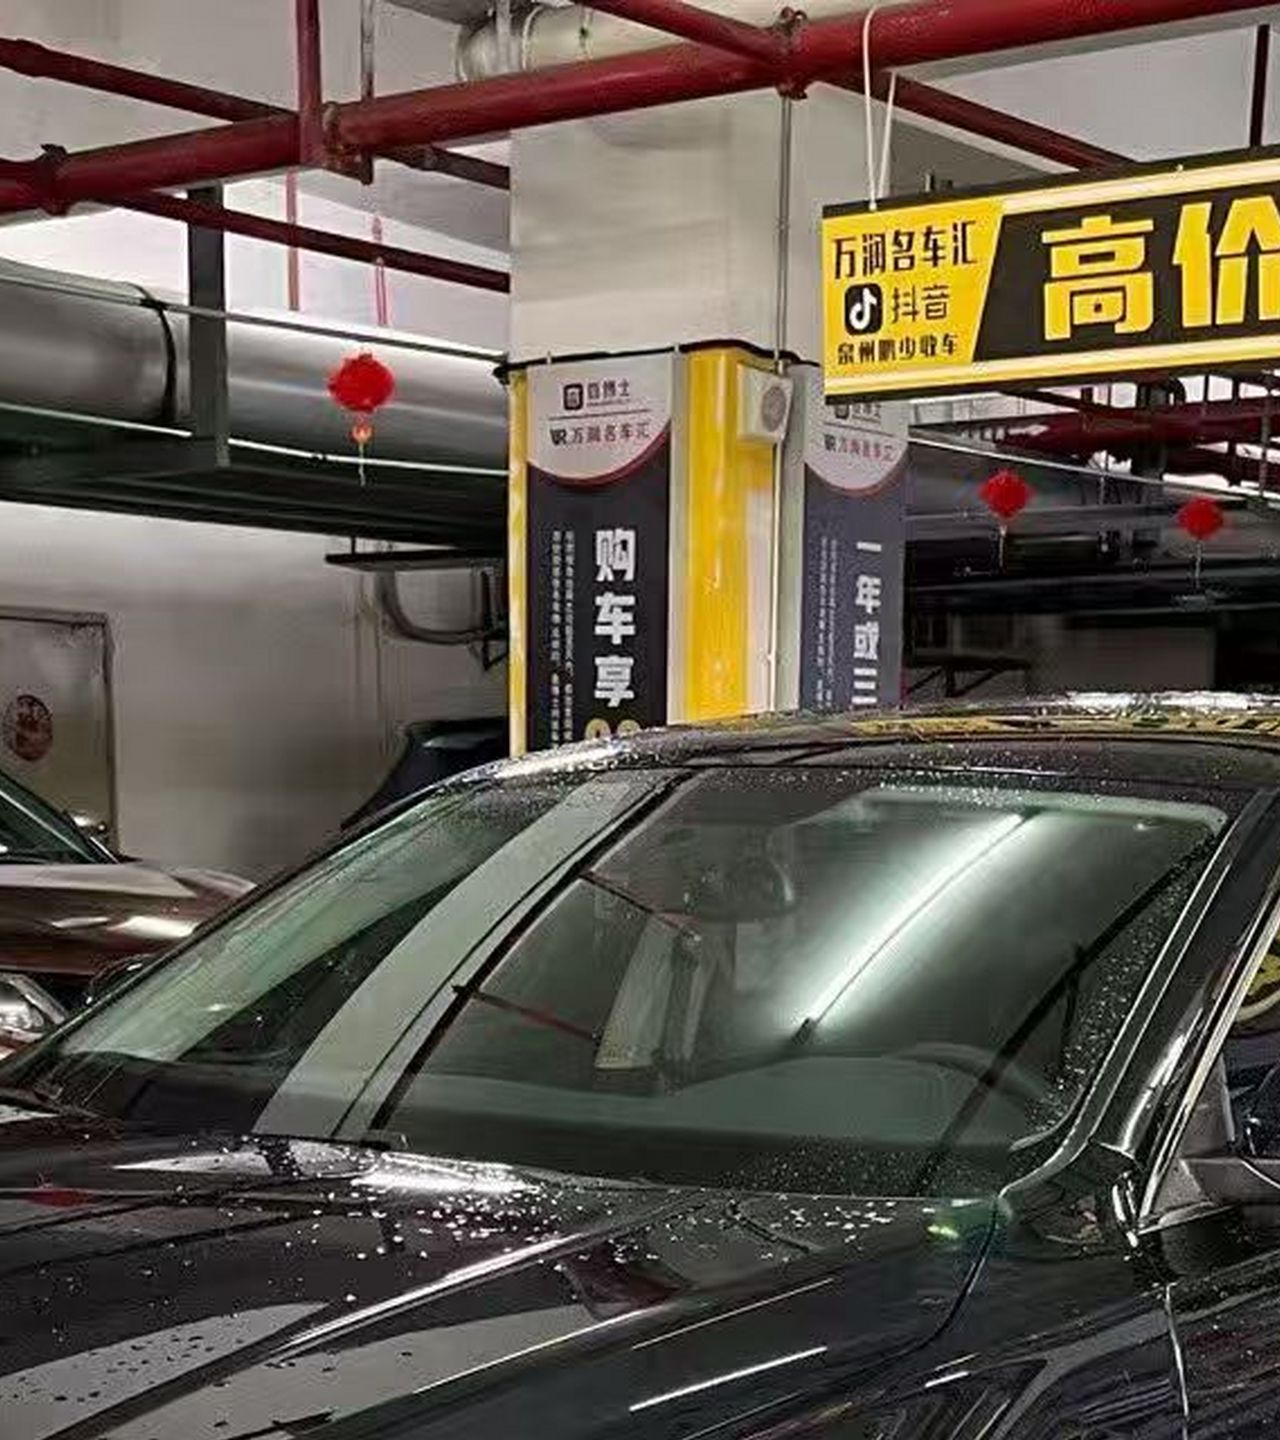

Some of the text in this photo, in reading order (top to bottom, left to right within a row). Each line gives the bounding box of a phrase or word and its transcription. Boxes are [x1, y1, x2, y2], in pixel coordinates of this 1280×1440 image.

[831, 221, 977, 280] 万润名车汇
[891, 284, 950, 325] 抖音
[594, 528, 636, 708] 购车享
